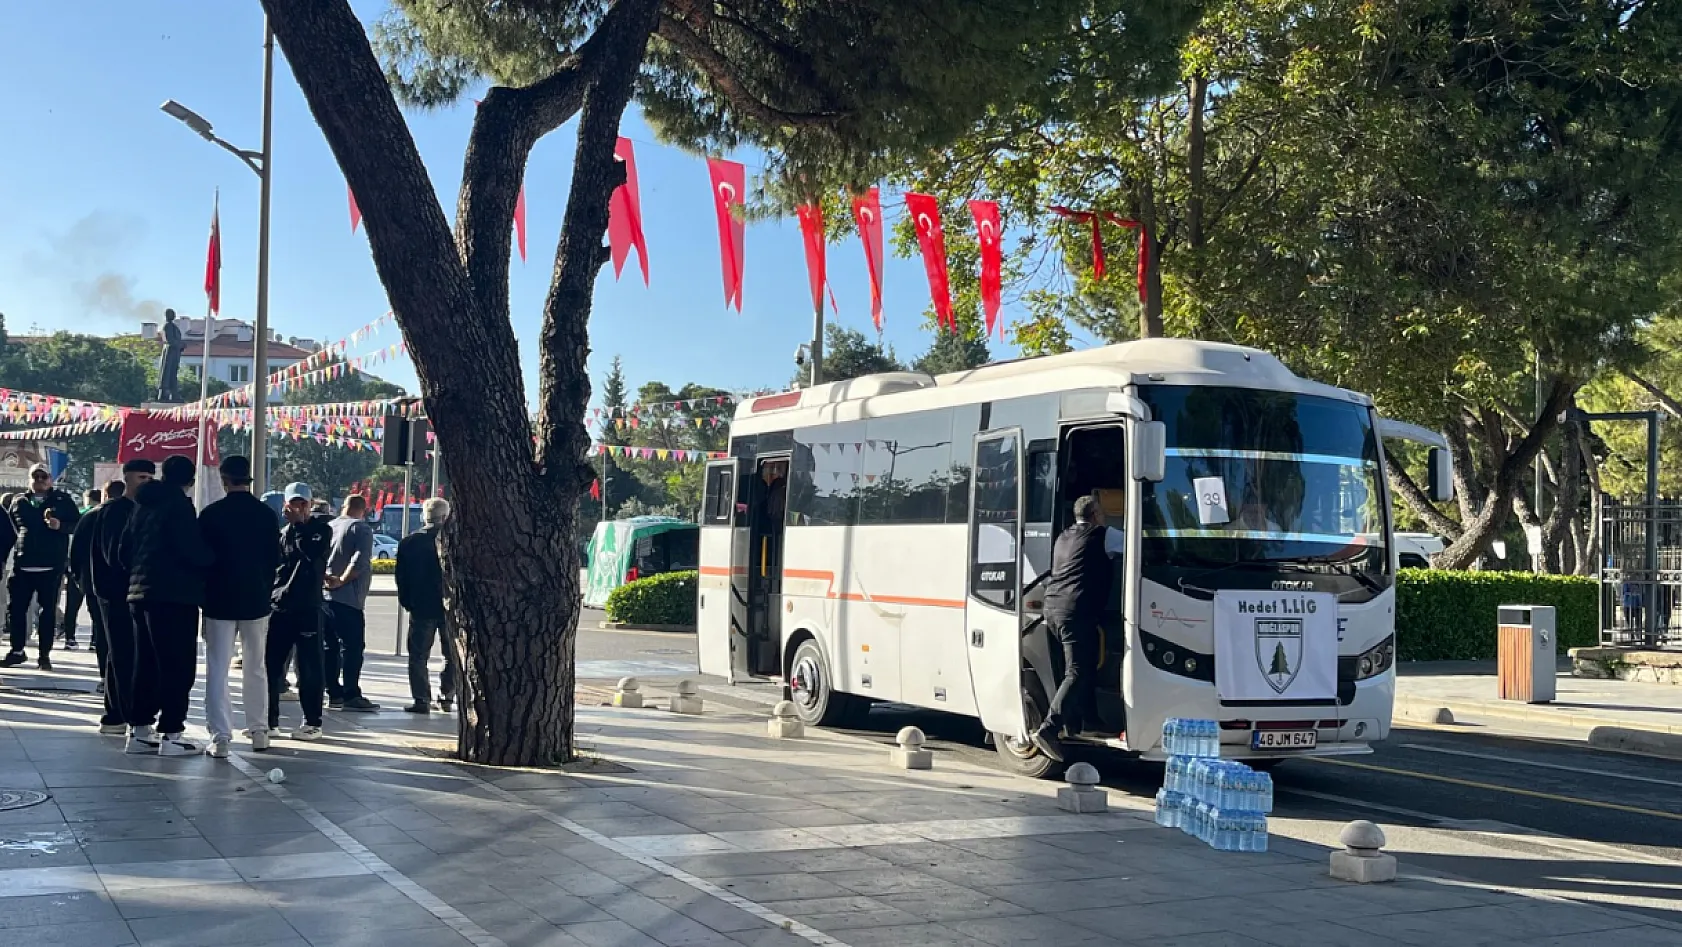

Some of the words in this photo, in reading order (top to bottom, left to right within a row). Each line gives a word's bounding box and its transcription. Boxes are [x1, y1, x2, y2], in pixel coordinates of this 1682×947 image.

[1203, 492, 1220, 506] 39
[1271, 580, 1313, 590] OTOKAR
[1238, 600, 1277, 613] Hedef
[1260, 733, 1274, 745] 48
[1276, 733, 1291, 745] JM
[1294, 732, 1314, 745] 647
